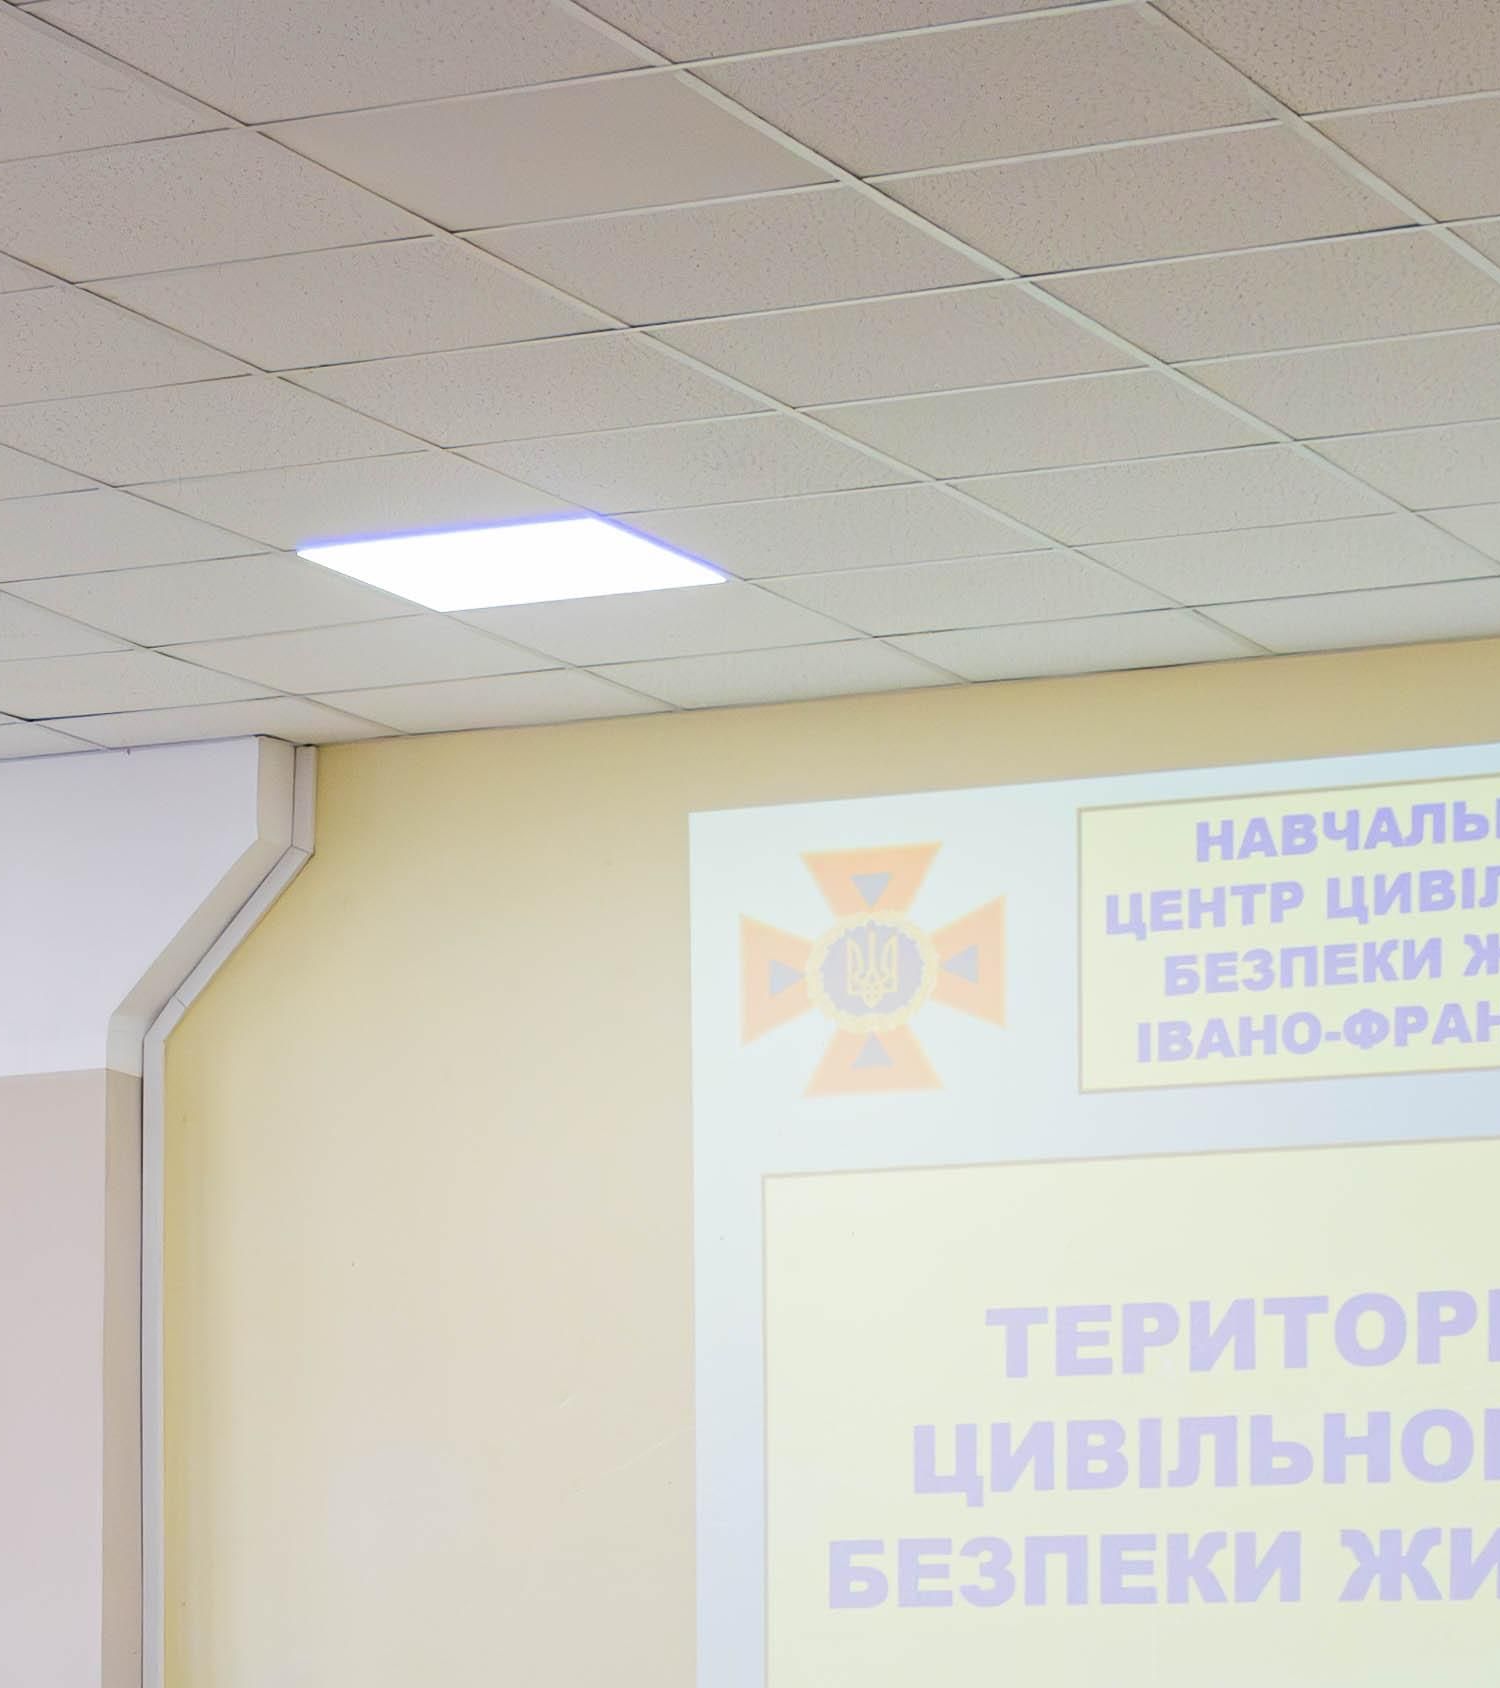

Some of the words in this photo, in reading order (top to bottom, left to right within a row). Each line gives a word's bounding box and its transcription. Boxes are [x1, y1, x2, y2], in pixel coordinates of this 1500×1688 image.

[1104, 878, 1306, 942] ЦЕНТР
[1163, 935, 1444, 999] БЕЗПЕКИ
[827, 1529, 1303, 1610] БЕЗПЕКИ
